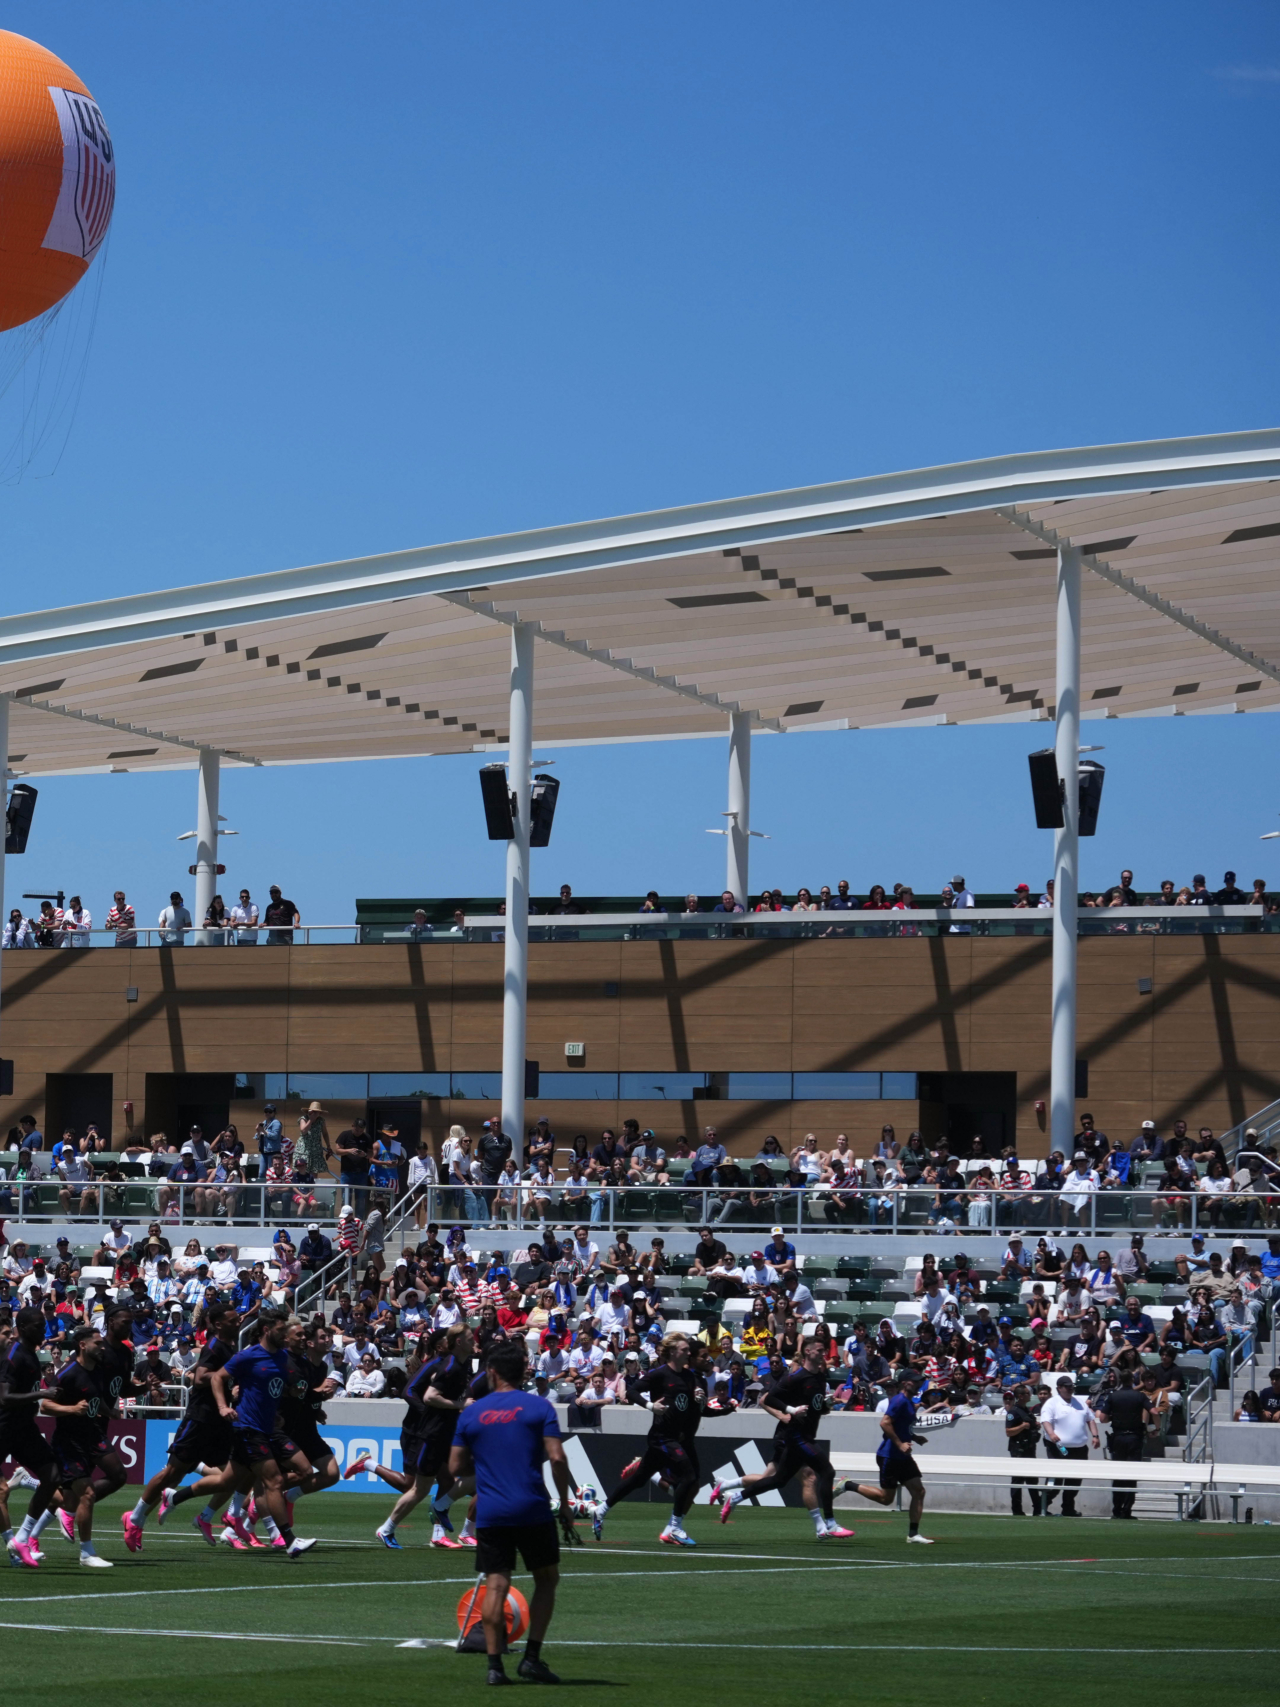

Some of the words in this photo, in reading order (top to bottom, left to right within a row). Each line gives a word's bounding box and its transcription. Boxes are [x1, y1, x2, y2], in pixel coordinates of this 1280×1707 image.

[72, 98, 114, 164] US
[568, 1044, 581, 1055] EXIT
[926, 1414, 950, 1427] USA
